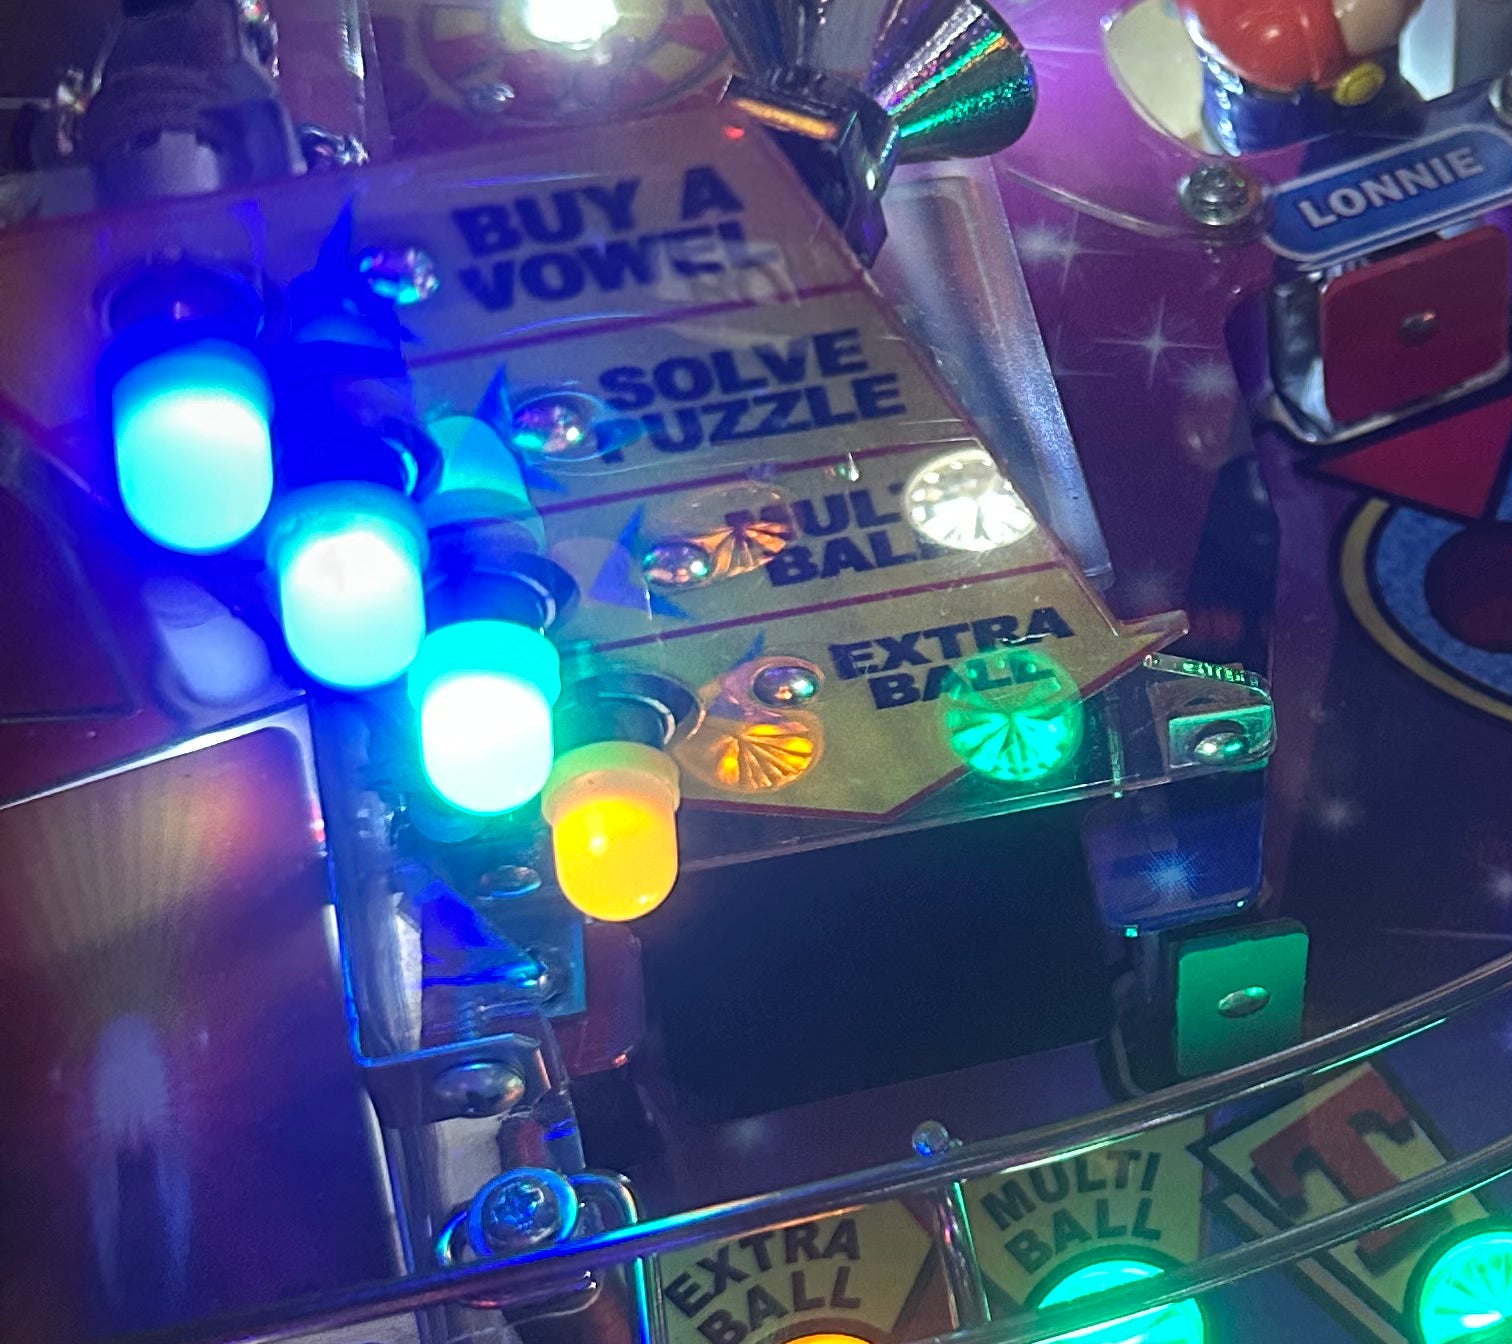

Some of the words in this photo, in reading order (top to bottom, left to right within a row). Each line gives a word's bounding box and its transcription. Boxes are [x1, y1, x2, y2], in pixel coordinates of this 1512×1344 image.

[451, 184, 640, 254] BUY
[681, 166, 746, 217] A
[1298, 144, 1485, 232] LONNIE
[456, 222, 764, 314] VOWEL
[599, 327, 870, 410] SOLVE
[828, 606, 1076, 681] EXTRA
[868, 652, 1058, 710] BALL
[981, 1150, 1162, 1230] MULTI
[664, 1217, 862, 1319] EXTRA
[1004, 1197, 1162, 1276] BALL
